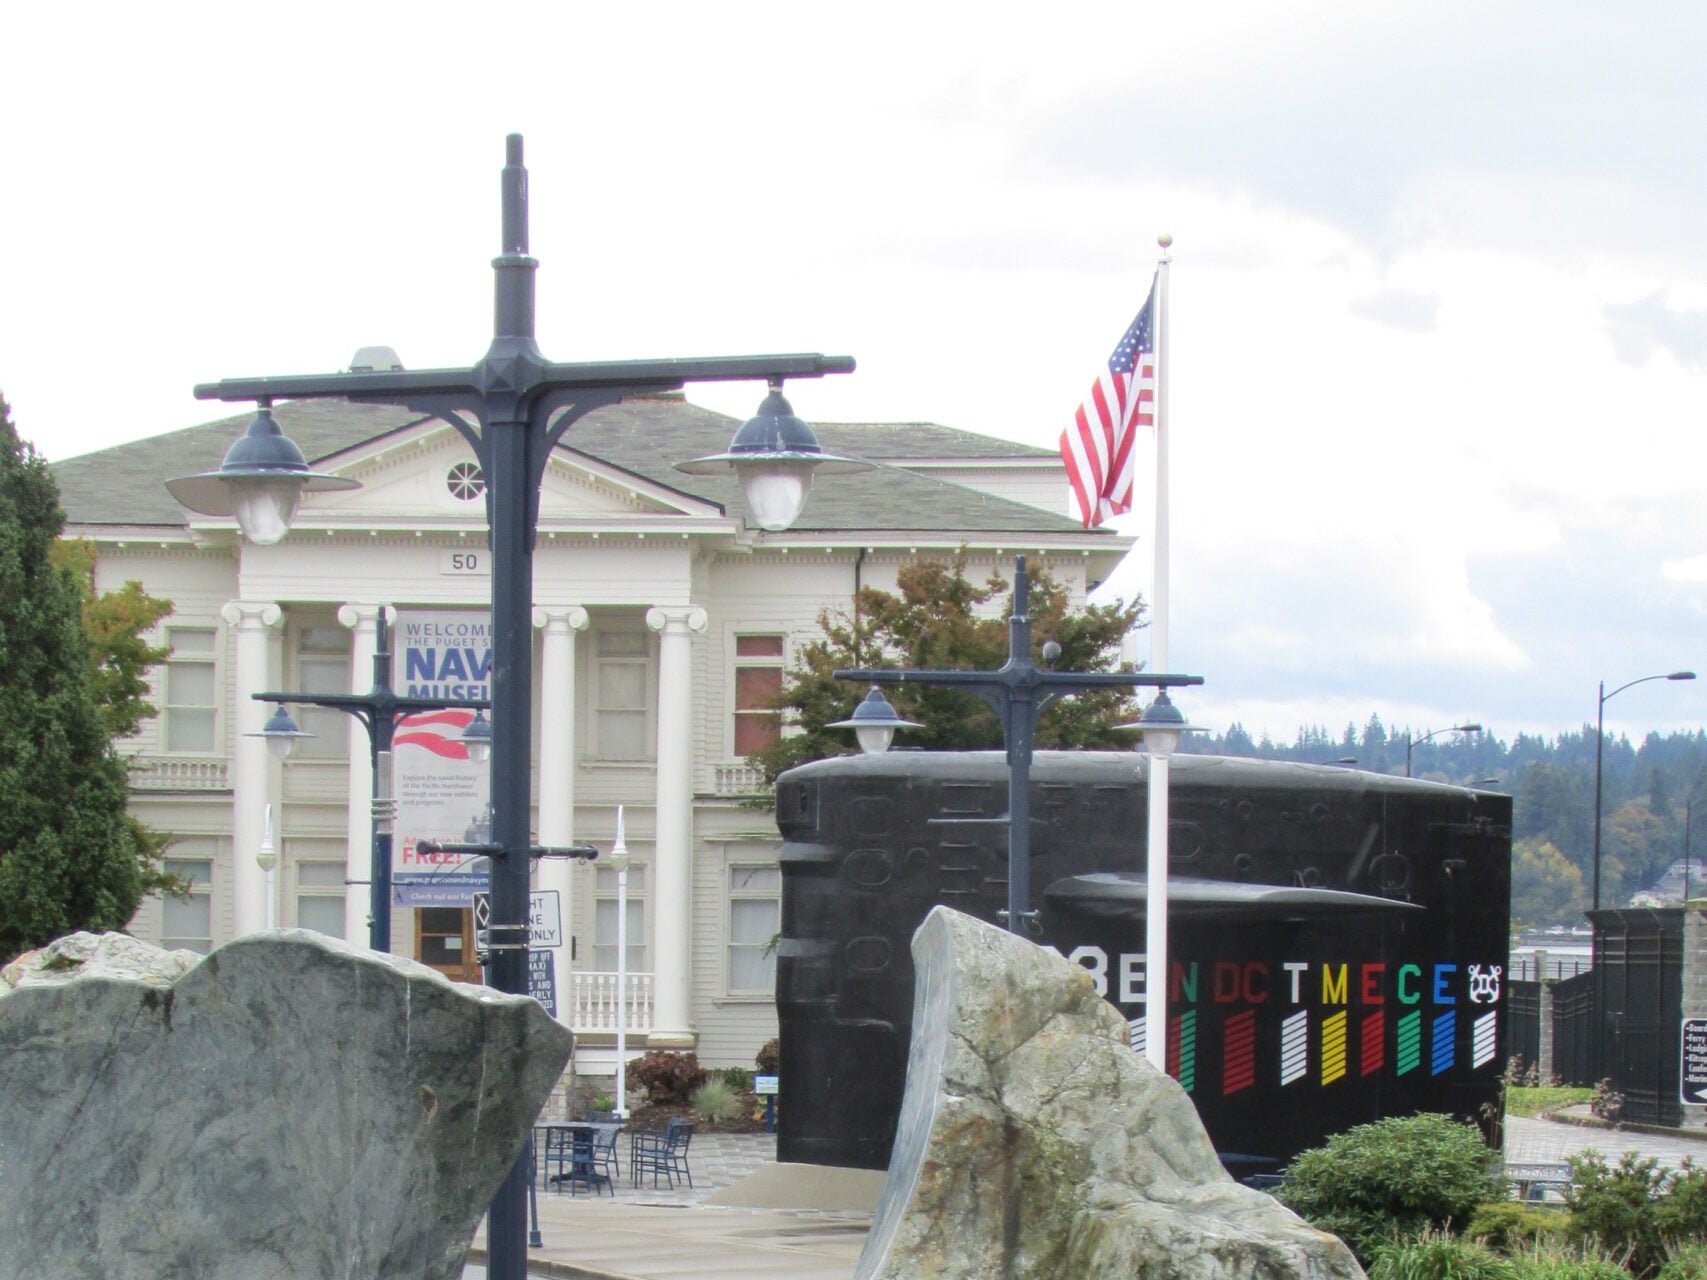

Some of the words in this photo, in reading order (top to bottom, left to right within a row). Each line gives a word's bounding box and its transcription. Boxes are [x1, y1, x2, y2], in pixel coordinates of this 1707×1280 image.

[453, 554, 477, 569] 50
[407, 638, 430, 646] THE
[436, 638, 476, 647] PUGET
[1283, 962, 1308, 1004] T
[1322, 963, 1348, 1004] M
[1361, 963, 1386, 1004] E
[1398, 963, 1422, 1004] C
[1433, 963, 1457, 1004] E
